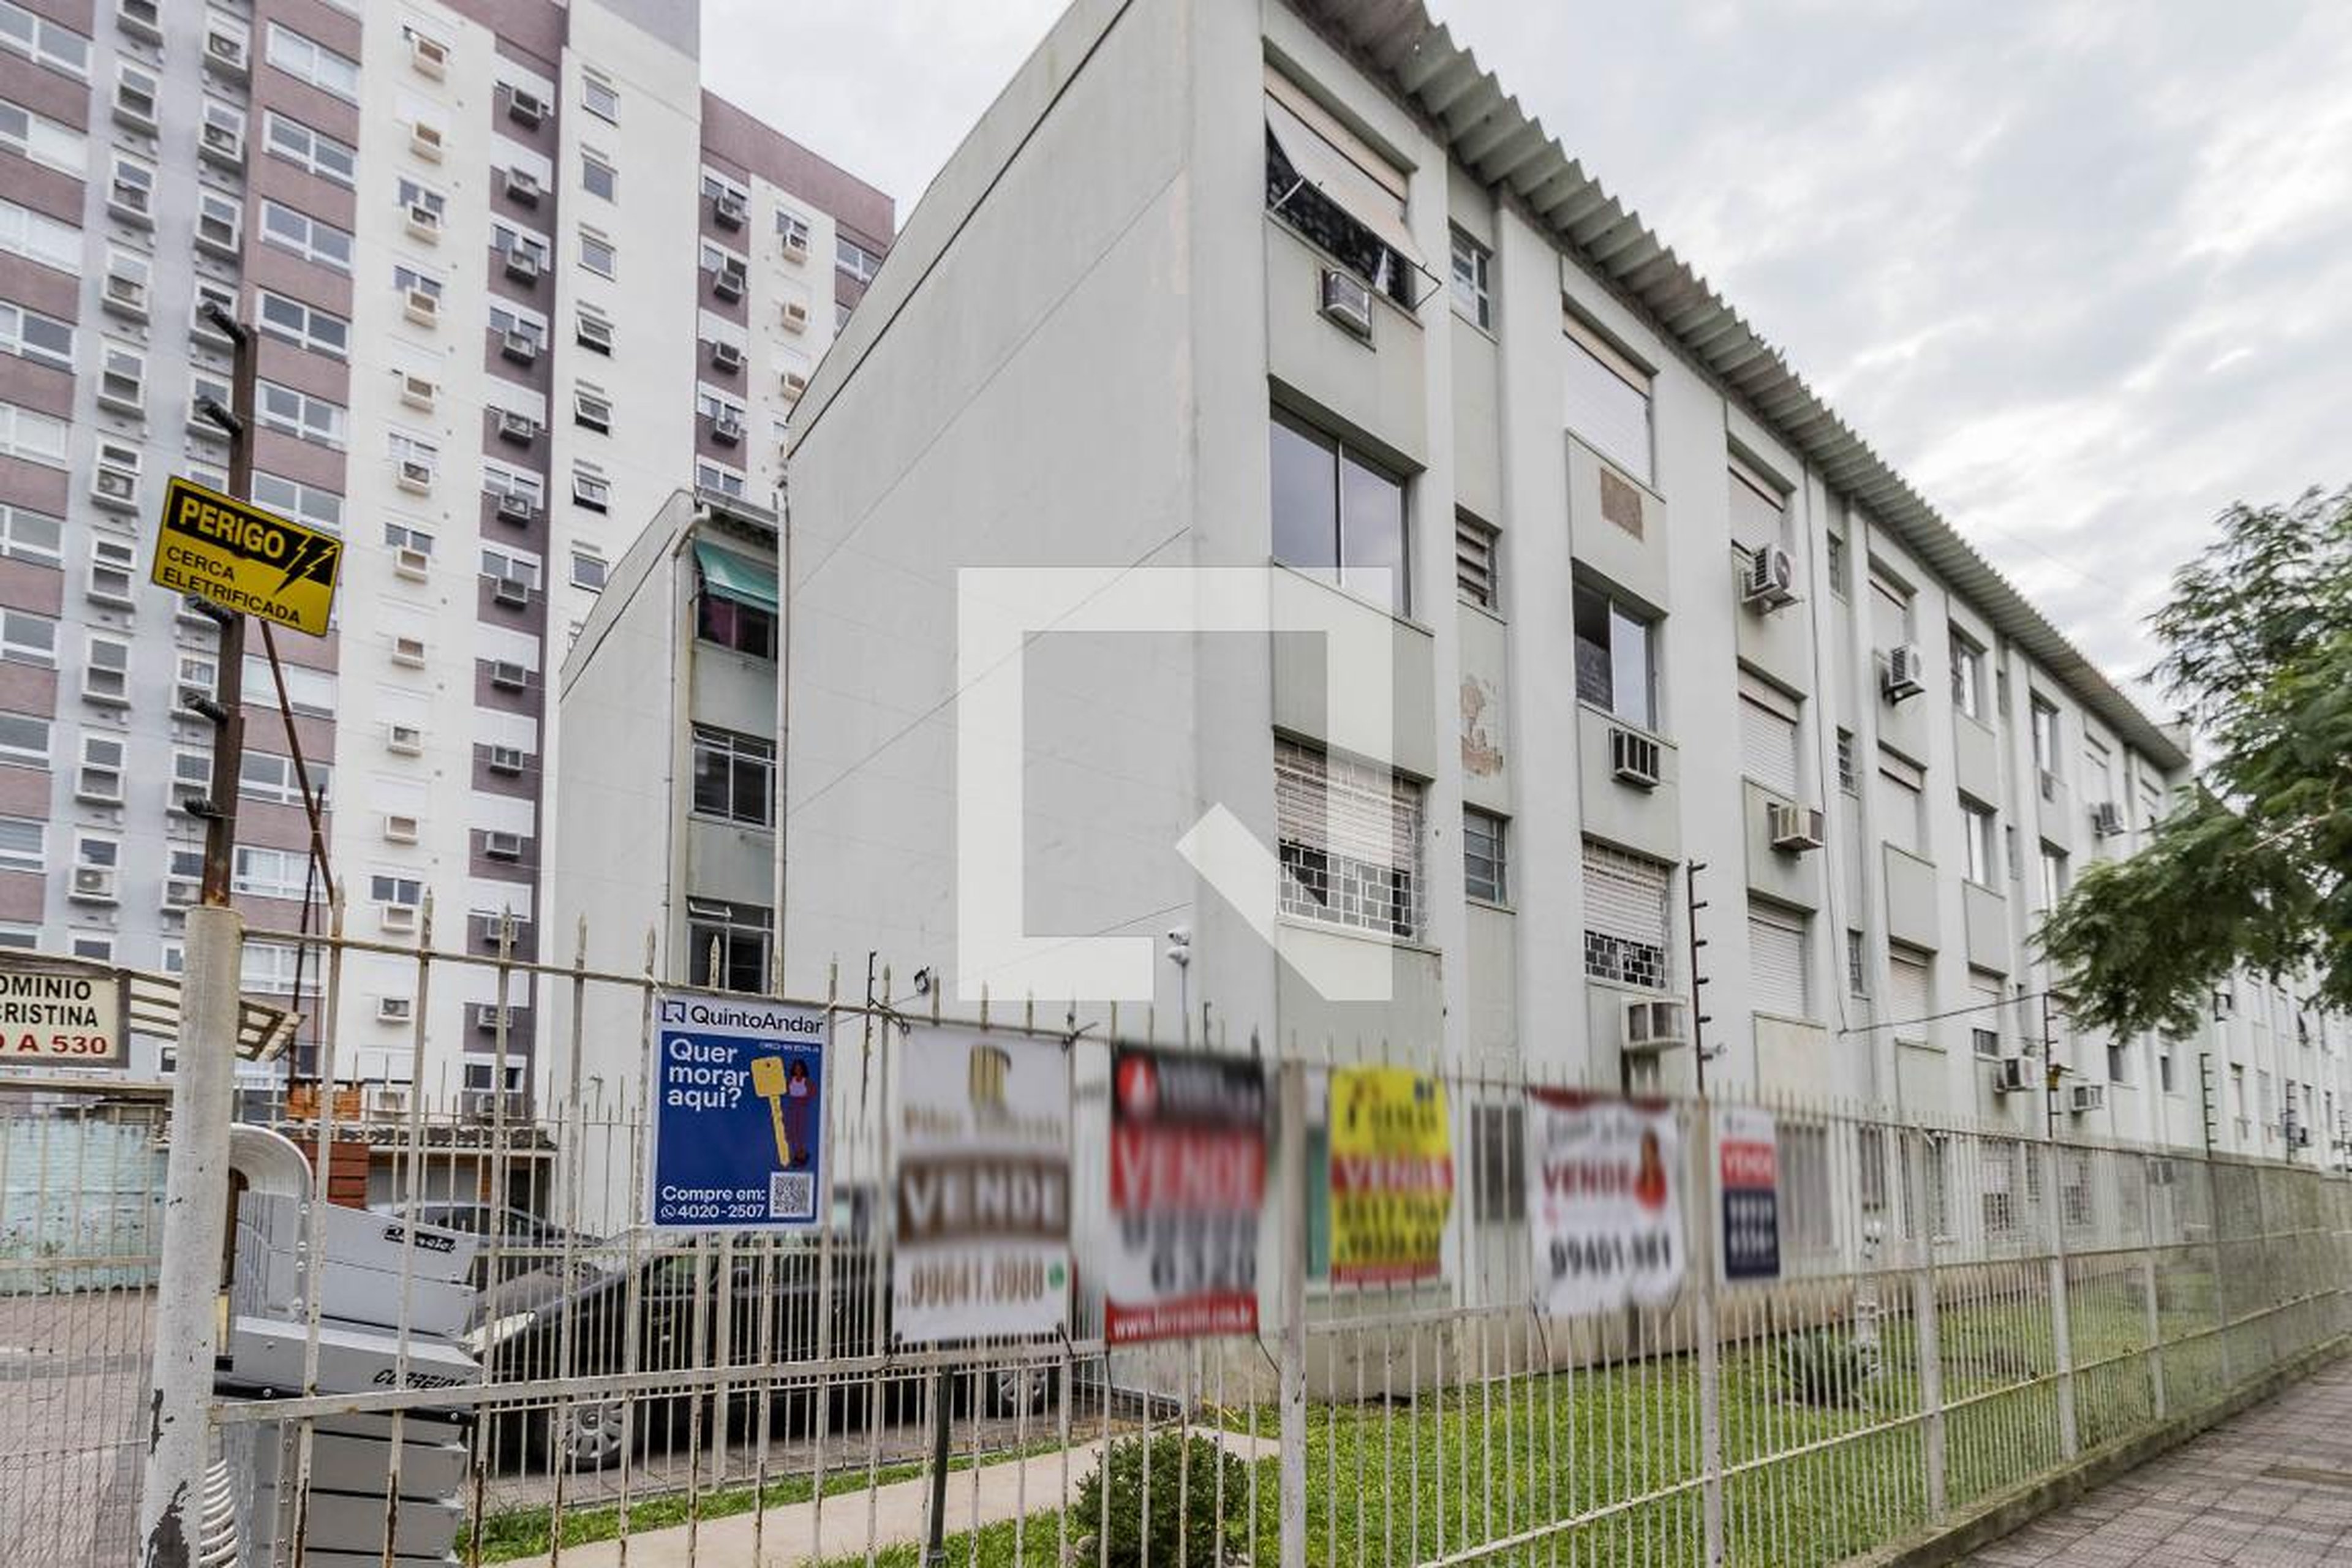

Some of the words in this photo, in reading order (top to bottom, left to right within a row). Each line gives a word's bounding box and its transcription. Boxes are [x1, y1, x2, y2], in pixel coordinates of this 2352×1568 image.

[179, 496, 285, 558] PERIGO
[166, 546, 235, 581] CERCA
[162, 567, 301, 624] ELETRIFICADA
[690, 1006, 824, 1034] QuintoAndar
[17, 1035, 39, 1052] A
[51, 1036, 107, 1054] 530
[669, 1038, 739, 1063] Quer
[668, 1065, 749, 1087] morar
[666, 1087, 742, 1111] aqui?
[662, 1186, 734, 1204] Compre
[736, 1188, 766, 1201] em:
[677, 1204, 764, 1218] 4020-2507
